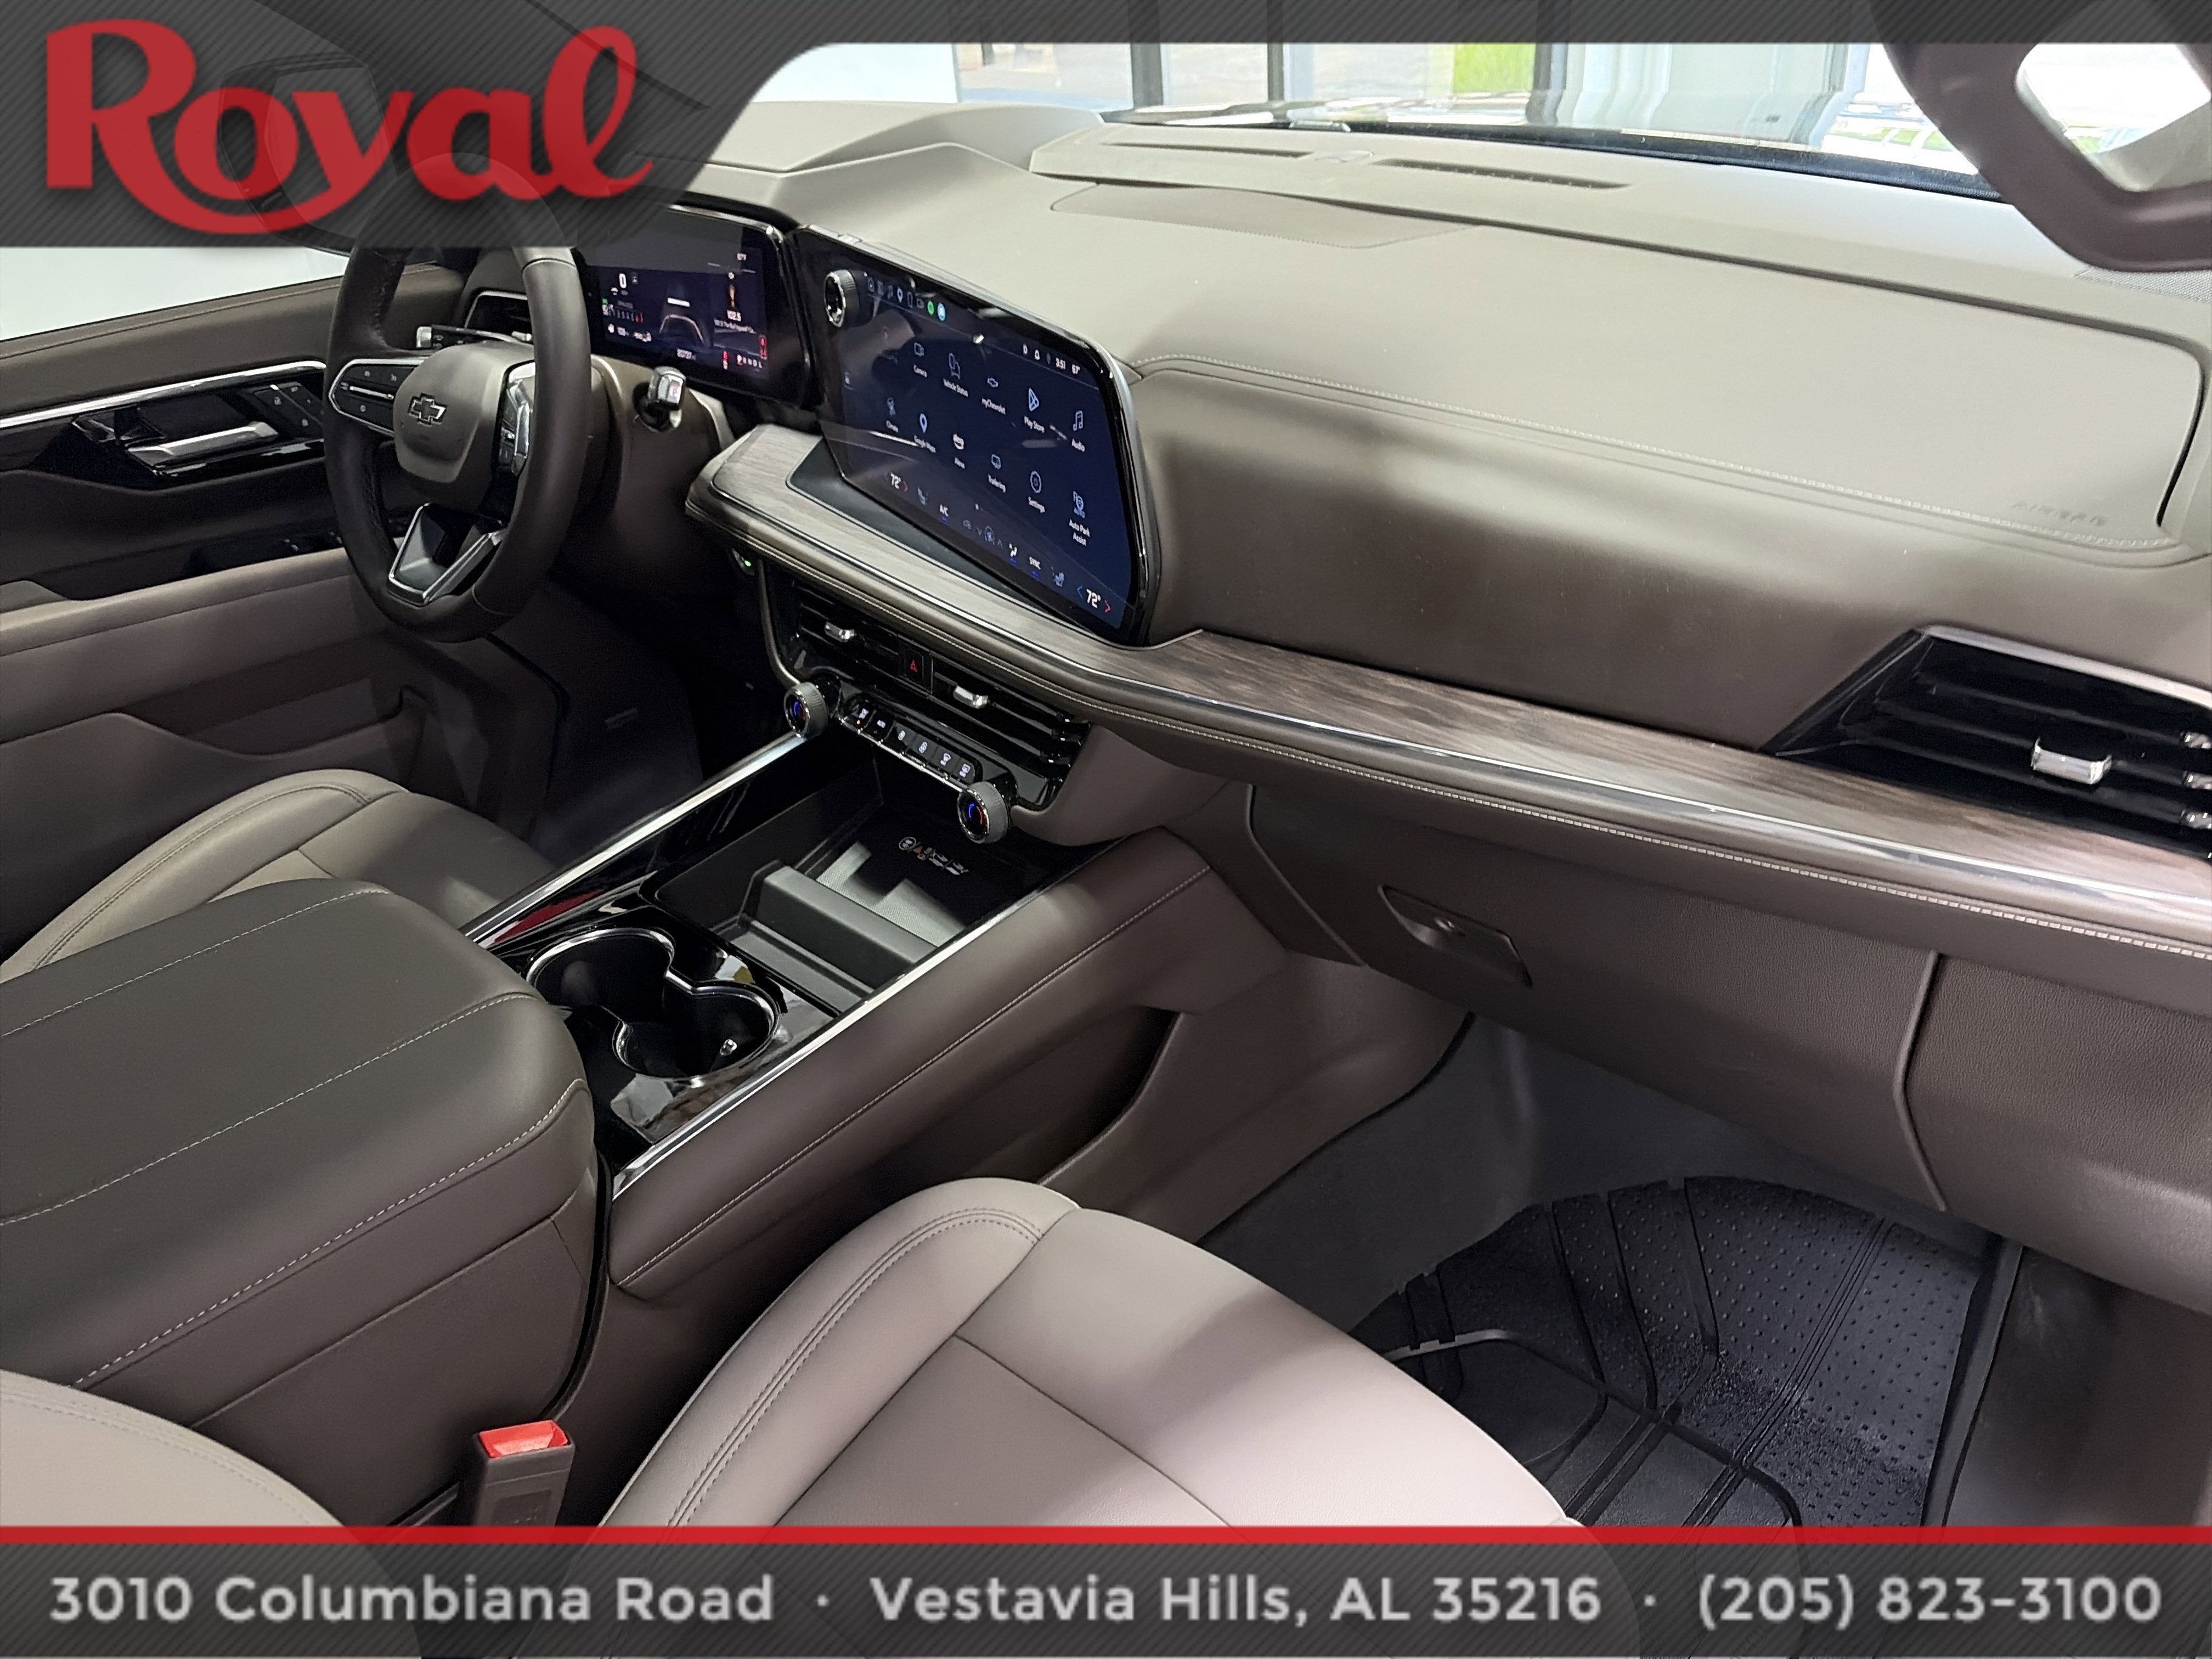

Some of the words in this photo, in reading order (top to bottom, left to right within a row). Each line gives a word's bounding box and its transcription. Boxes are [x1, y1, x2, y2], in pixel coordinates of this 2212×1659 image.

[1024, 416, 1033, 430] Play
[1033, 420, 1045, 433] Store
[1071, 438, 1086, 452] Audio
[1069, 519, 1080, 532] Auto
[1080, 524, 1091, 538] Park
[1073, 532, 1087, 546] Assist
[1086, 589, 1101, 608] 72°
